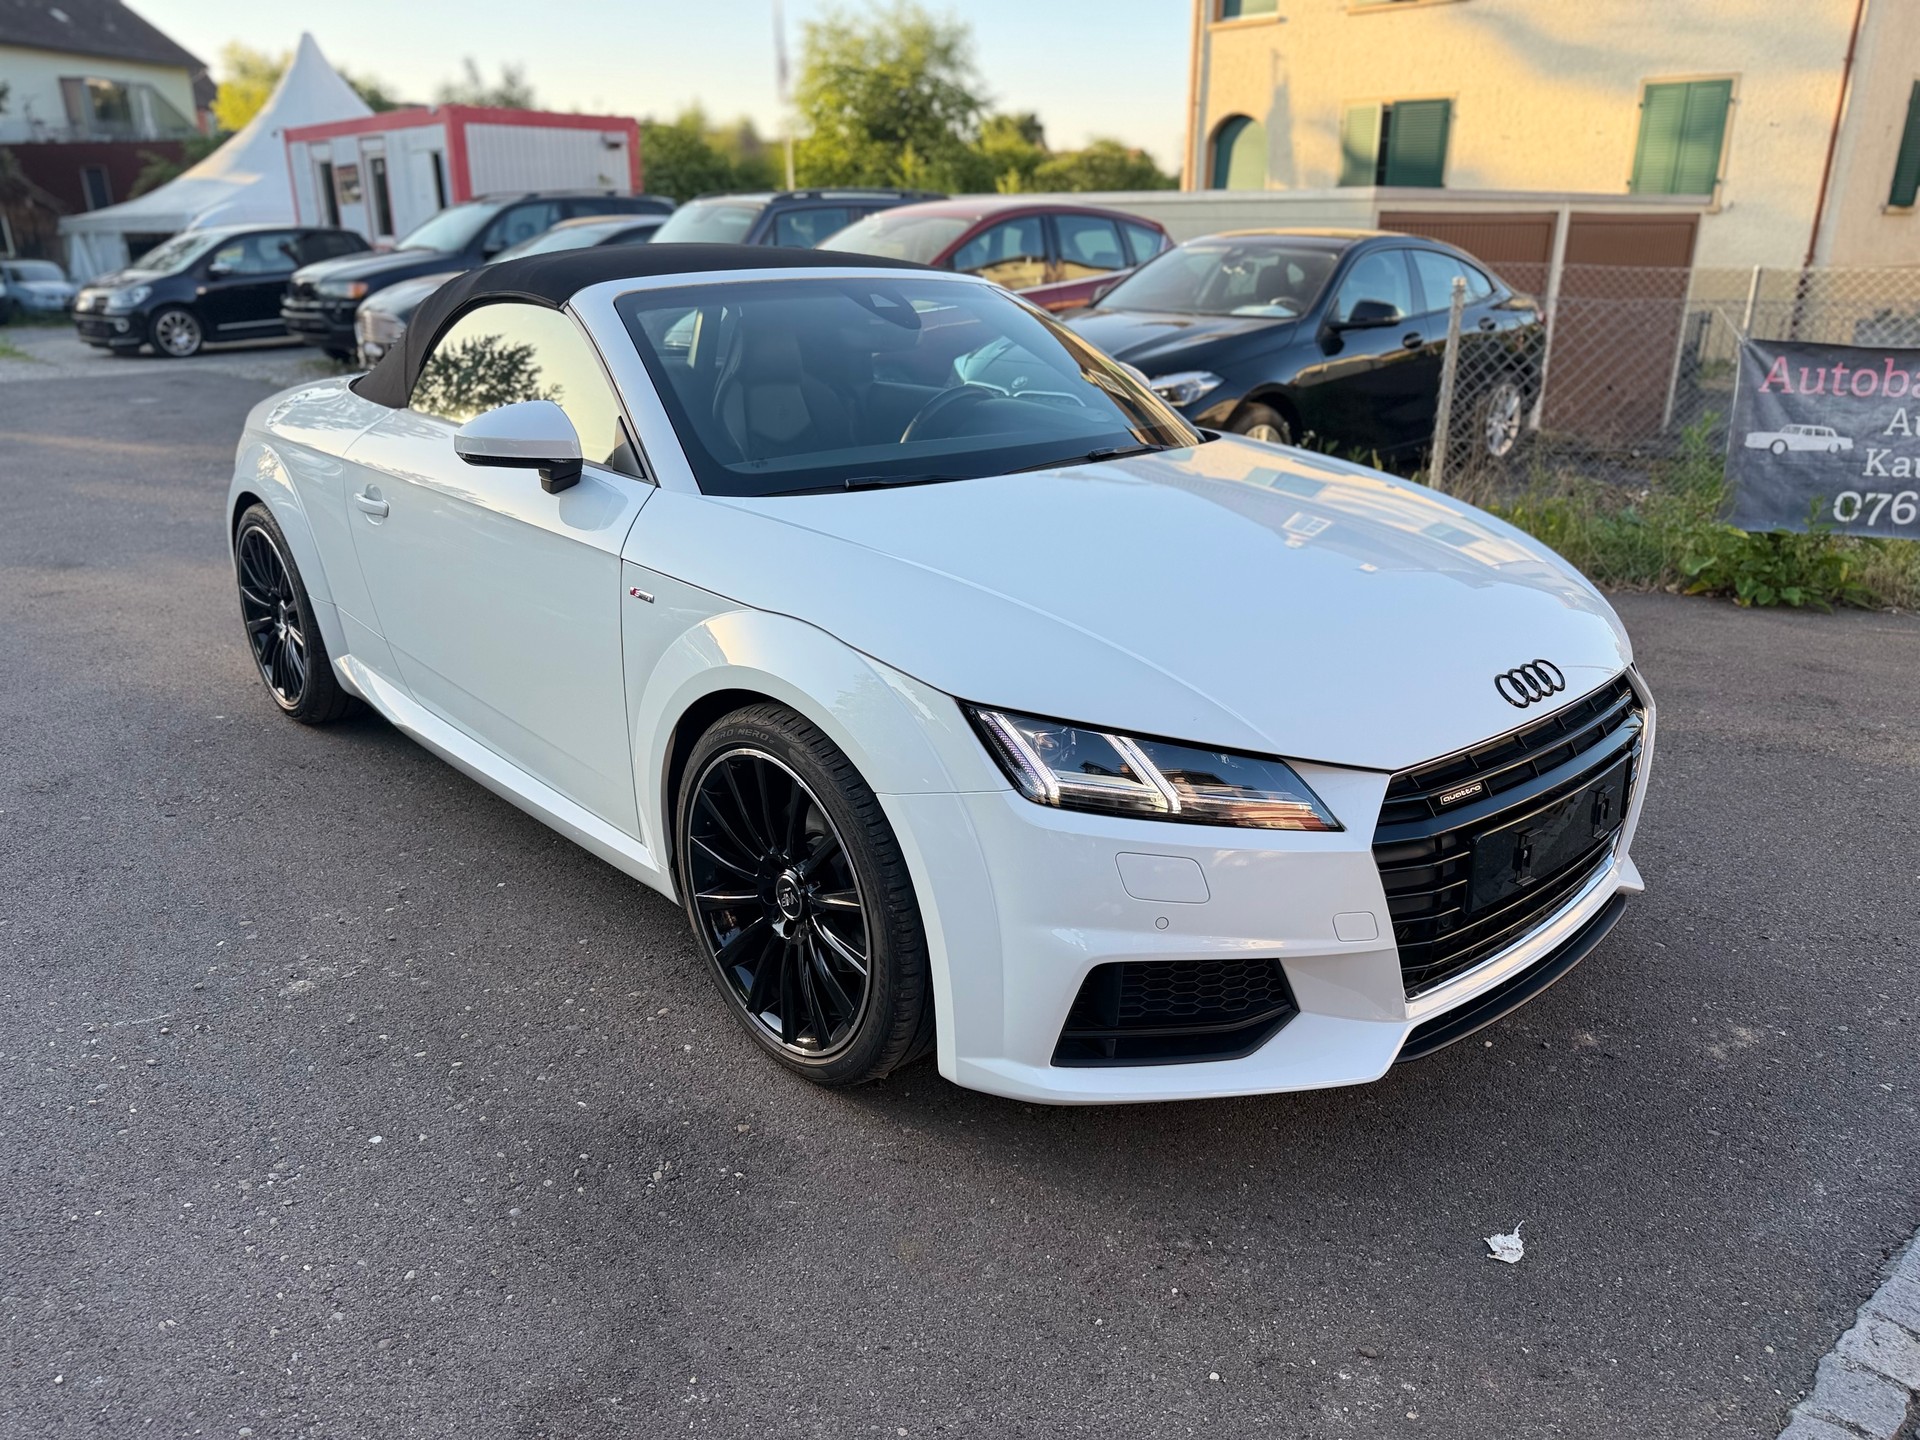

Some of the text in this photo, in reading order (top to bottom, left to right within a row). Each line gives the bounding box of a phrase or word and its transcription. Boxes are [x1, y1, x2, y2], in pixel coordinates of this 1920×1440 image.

[1883, 407, 1920, 436] A
[1862, 448, 1920, 479] Ka
[1833, 490, 1919, 526] 076
[738, 728, 769, 741] NERO
[1443, 785, 1481, 803] quattro
